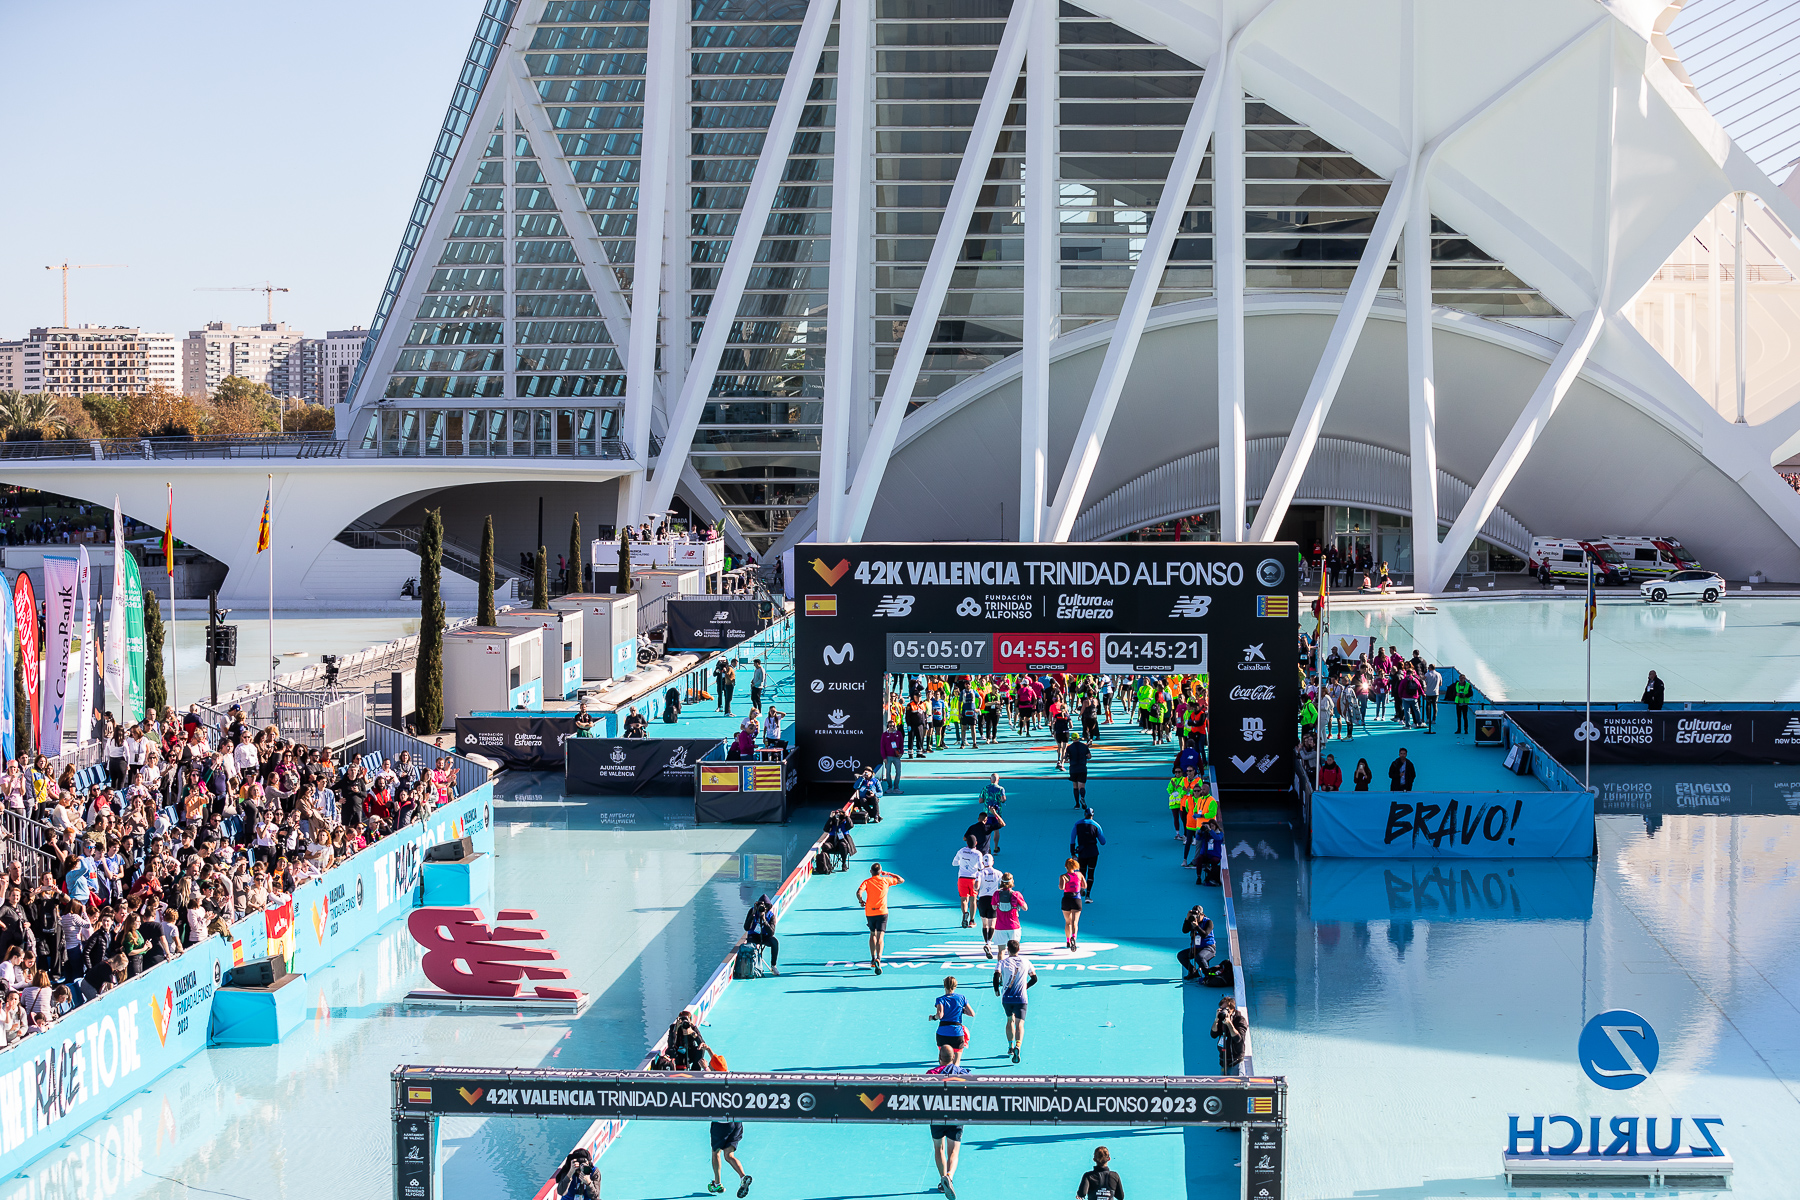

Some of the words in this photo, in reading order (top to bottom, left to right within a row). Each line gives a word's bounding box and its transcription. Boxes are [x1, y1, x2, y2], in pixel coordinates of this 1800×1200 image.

[854, 561, 904, 584] 42K
[907, 562, 1020, 585] VALENCIA
[1024, 562, 1130, 585] TRINIDAD
[1132, 562, 1244, 586] ALFONSO
[872, 595, 915, 617] NB
[985, 602, 1032, 610] TRINIDAD
[1058, 594, 1101, 606] Cultura
[1168, 595, 1212, 617] NB
[985, 611, 1032, 619] ALFONSO
[1057, 606, 1113, 619] Esfuerzo
[893, 640, 986, 658] 05:05:07
[1000, 640, 1094, 658] 04:55:16
[1107, 641, 1198, 658] 04:45:21
[828, 682, 865, 690] ZURICH
[1230, 685, 1276, 700] Coca-Cola
[1604, 726, 1653, 734] TRINIDAD
[1678, 718, 1720, 730] Cultura
[1604, 735, 1653, 744] ALFONSO
[1676, 731, 1732, 744] Esfuerzo
[836, 756, 860, 772] edp
[1384, 799, 1523, 852] BRAVO!
[824, 961, 934, 969] new
[940, 961, 1153, 972] baance
[175, 970, 197, 997] VALENCIA
[178, 1016, 188, 1036] 2023
[87, 1014, 118, 1096] TO
[118, 999, 140, 1078] BE
[486, 1089, 519, 1105] 42K
[520, 1089, 596, 1106] VALENCIA
[597, 1090, 668, 1107] TRINIDAD
[670, 1091, 743, 1108] ALFONSO
[745, 1092, 790, 1109] 2023
[887, 1094, 920, 1110] 42K
[925, 1095, 998, 1111] VALENCIA
[1000, 1096, 1072, 1112] TRINIDAD
[1074, 1096, 1148, 1113] ALFONSO
[1150, 1096, 1196, 1113] 2023
